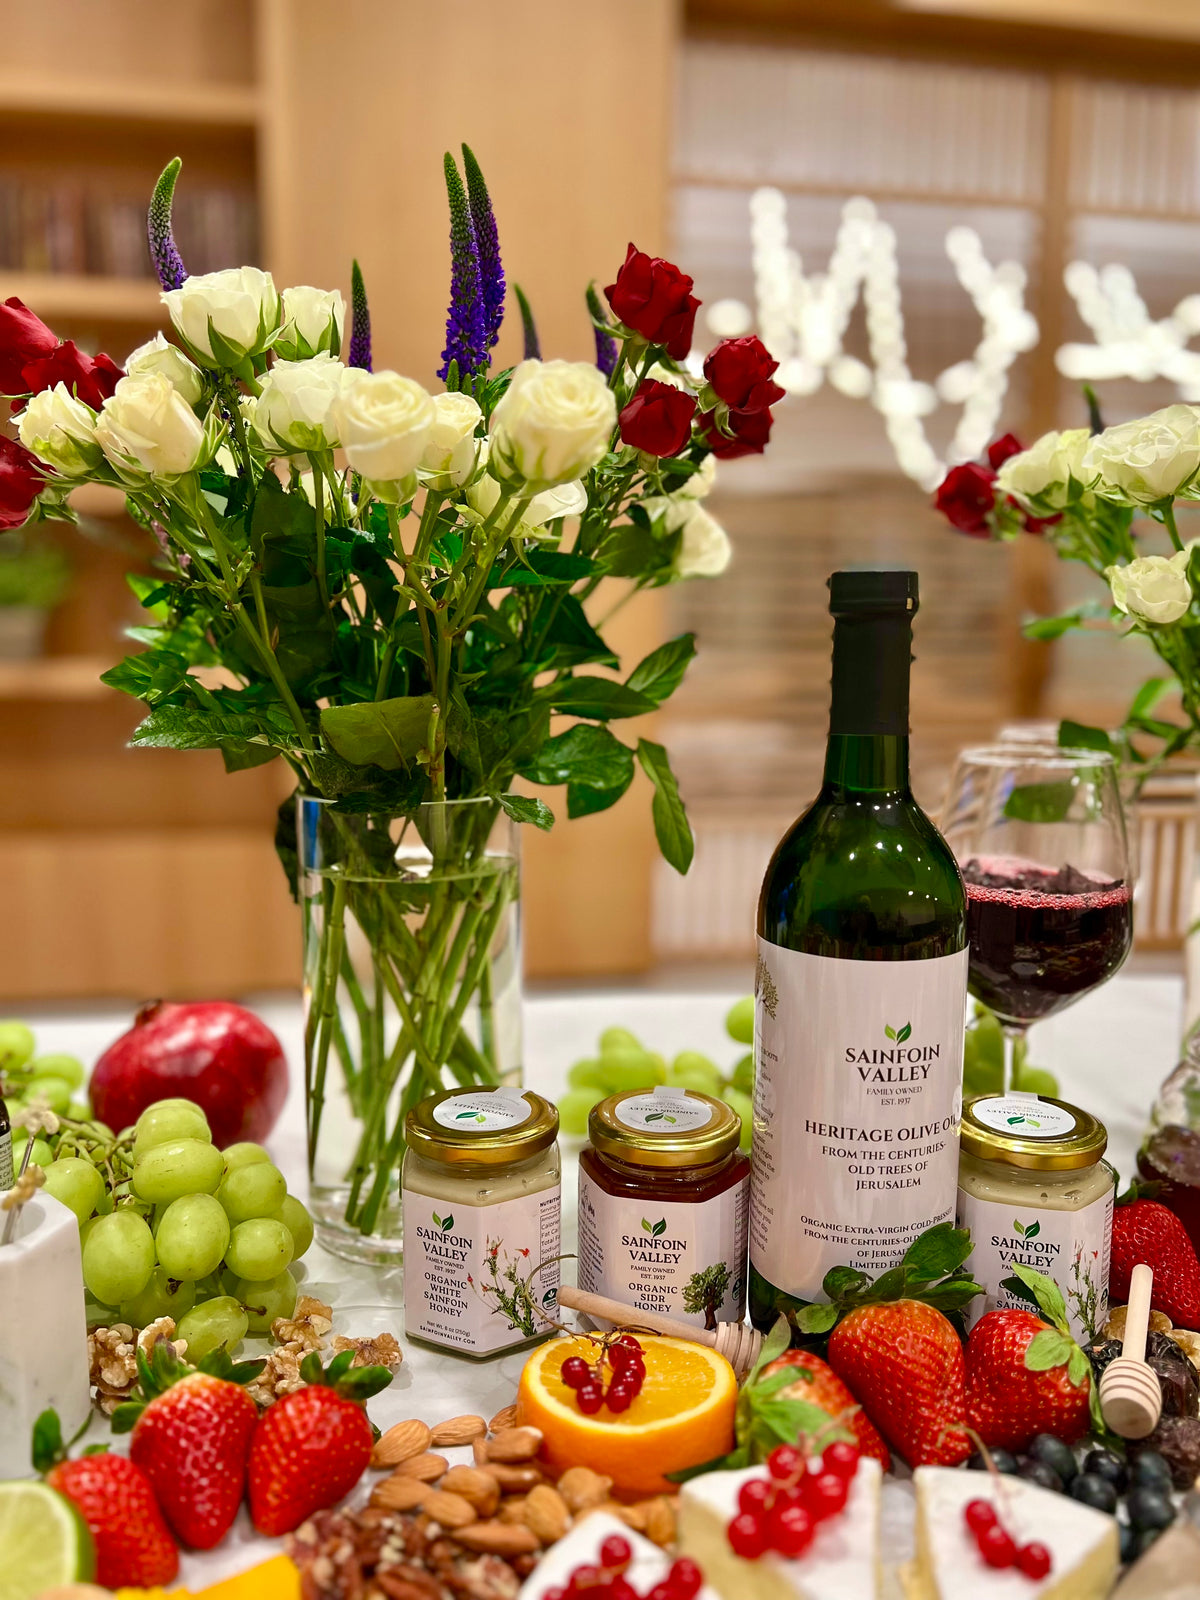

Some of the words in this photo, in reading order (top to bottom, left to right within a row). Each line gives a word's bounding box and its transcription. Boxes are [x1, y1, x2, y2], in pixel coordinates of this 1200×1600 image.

[845, 1043, 940, 1065] SAINFOIN
[857, 1063, 932, 1082] VALLEY
[866, 1087, 894, 1096] FAMILY
[895, 1086, 922, 1095] OWNED
[881, 1098, 896, 1106] EST.
[897, 1097, 911, 1105] 1937
[805, 1120, 893, 1142] HERITAGE
[897, 1121, 940, 1141] OLIVE
[942, 1114, 957, 1131] OIL
[822, 1145, 857, 1160] FROM
[860, 1150, 885, 1161] THE
[888, 1140, 947, 1160] CENTURIES-
[848, 1164, 875, 1175] OLD
[877, 1164, 913, 1175] TREES
[914, 1161, 929, 1172] OF
[856, 1177, 921, 1191] JERUSALEM
[800, 1215, 843, 1232] ORGANIC
[844, 1224, 909, 1235] EXTRA-VIRGIN
[416, 1226, 473, 1250] SAINFOIN
[621, 1235, 687, 1251] SAINFOIN
[804, 1228, 829, 1241] FROM
[831, 1234, 849, 1245] THE
[422, 1241, 468, 1262] VALLEY
[991, 1236, 1061, 1254] SAINFOIN
[629, 1250, 682, 1264] VALLEY
[857, 1250, 870, 1258] OF
[999, 1250, 1054, 1267] VALLEY
[425, 1255, 443, 1266] FAMILY
[443, 1259, 465, 1270] OWNED
[630, 1265, 652, 1273] FAMILY
[652, 1267, 676, 1275] OWNED
[849, 1260, 887, 1269] LIMITED
[445, 1267, 456, 1275] 1937
[424, 1272, 467, 1290] ORGANIC
[628, 1282, 678, 1295] ORGANIC
[430, 1283, 461, 1298] WHITE
[640, 1293, 665, 1303] SIDR
[423, 1291, 468, 1310] SAINFOIN
[634, 1301, 672, 1312] HONEY
[429, 1302, 463, 1317] HONEY
[419, 1324, 476, 1345] SAINFOINVALLEY.COM
